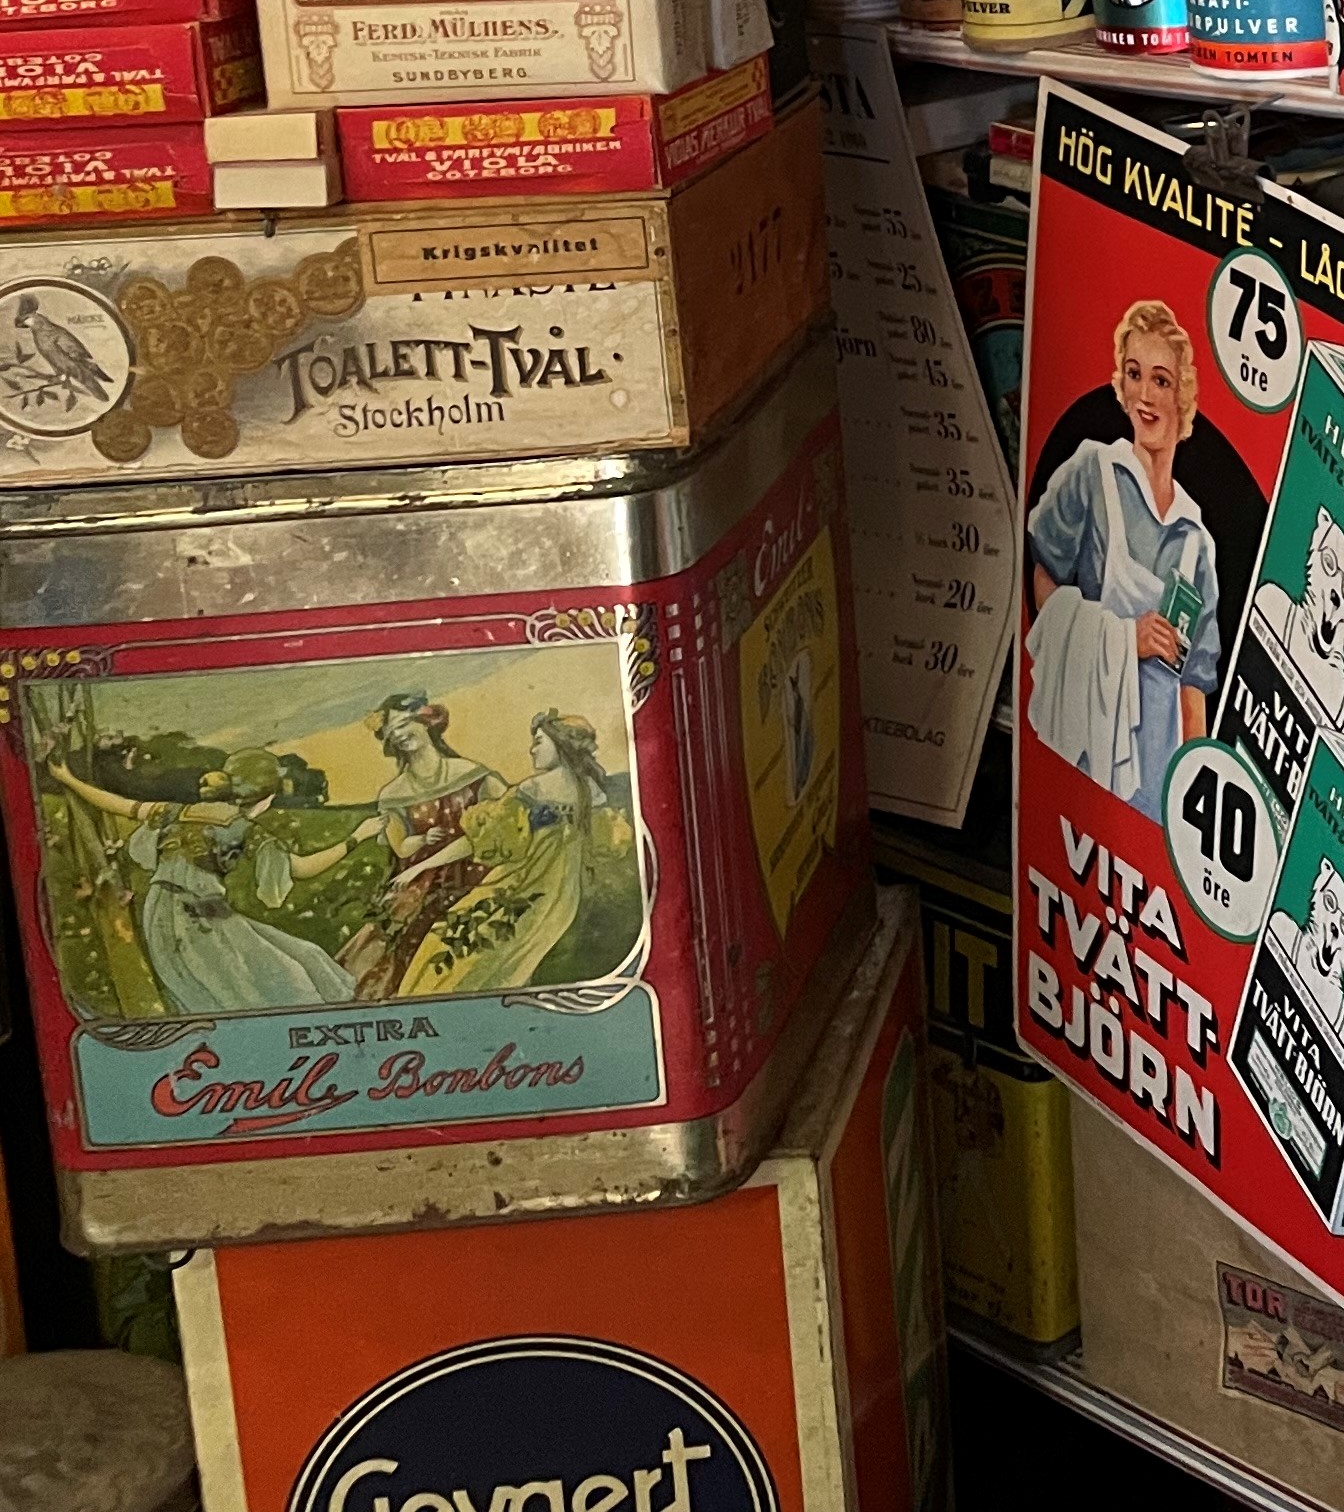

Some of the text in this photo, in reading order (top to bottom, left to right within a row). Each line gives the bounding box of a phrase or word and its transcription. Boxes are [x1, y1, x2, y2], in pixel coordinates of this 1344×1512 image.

[392, 67, 528, 83] SUNDBYBERG
[1225, 50, 1294, 63] TOMTEN
[372, 150, 421, 164] TVÅL
[440, 138, 622, 161] PARFYMFABRIKEN
[429, 153, 561, 172] VIOLA
[1058, 124, 1114, 188] HÖG
[1124, 155, 1257, 249] KVALITÉ
[422, 236, 599, 262] Krigskvalitet
[909, 316, 938, 348] 80
[1227, 267, 1288, 362] 75
[1240, 355, 1269, 394] öre
[333, 397, 505, 438] Stockholm
[932, 411, 962, 442] 35
[946, 468, 974, 499] 35
[951, 522, 980, 554] 30
[943, 579, 976, 612] 20
[924, 640, 959, 675] 30
[1181, 765, 1259, 884] 40
[1059, 815, 1186, 958] VITA
[1202, 867, 1232, 910] öre
[1027, 864, 1218, 1063] TVÄTT-
[288, 1016, 440, 1050] EXTRA
[1282, 994, 1321, 1072] VITA
[367, 1042, 586, 1103] Bonbons
[1027, 949, 1219, 1166] BJÖRN
[1223, 1272, 1288, 1324] TOR
